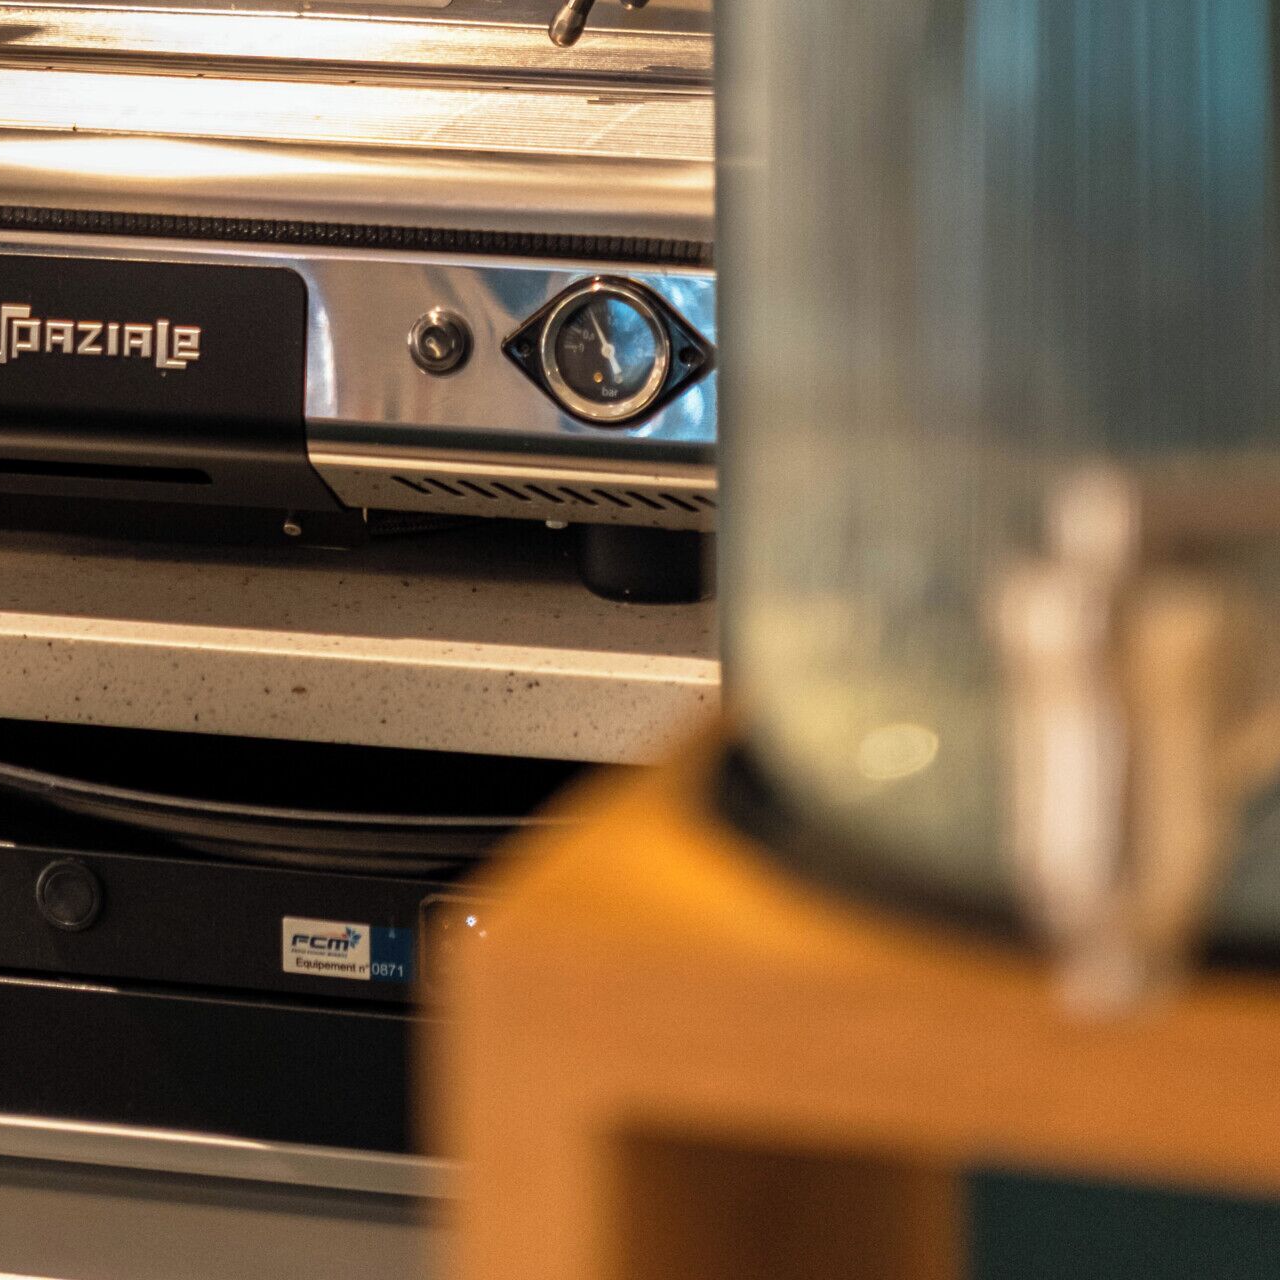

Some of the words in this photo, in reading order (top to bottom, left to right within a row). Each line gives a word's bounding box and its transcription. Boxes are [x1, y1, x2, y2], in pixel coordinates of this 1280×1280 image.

[601, 386, 618, 397] bar
[292, 934, 349, 951] FCM
[295, 957, 356, 973] Equipement
[371, 962, 404, 978] 0871
